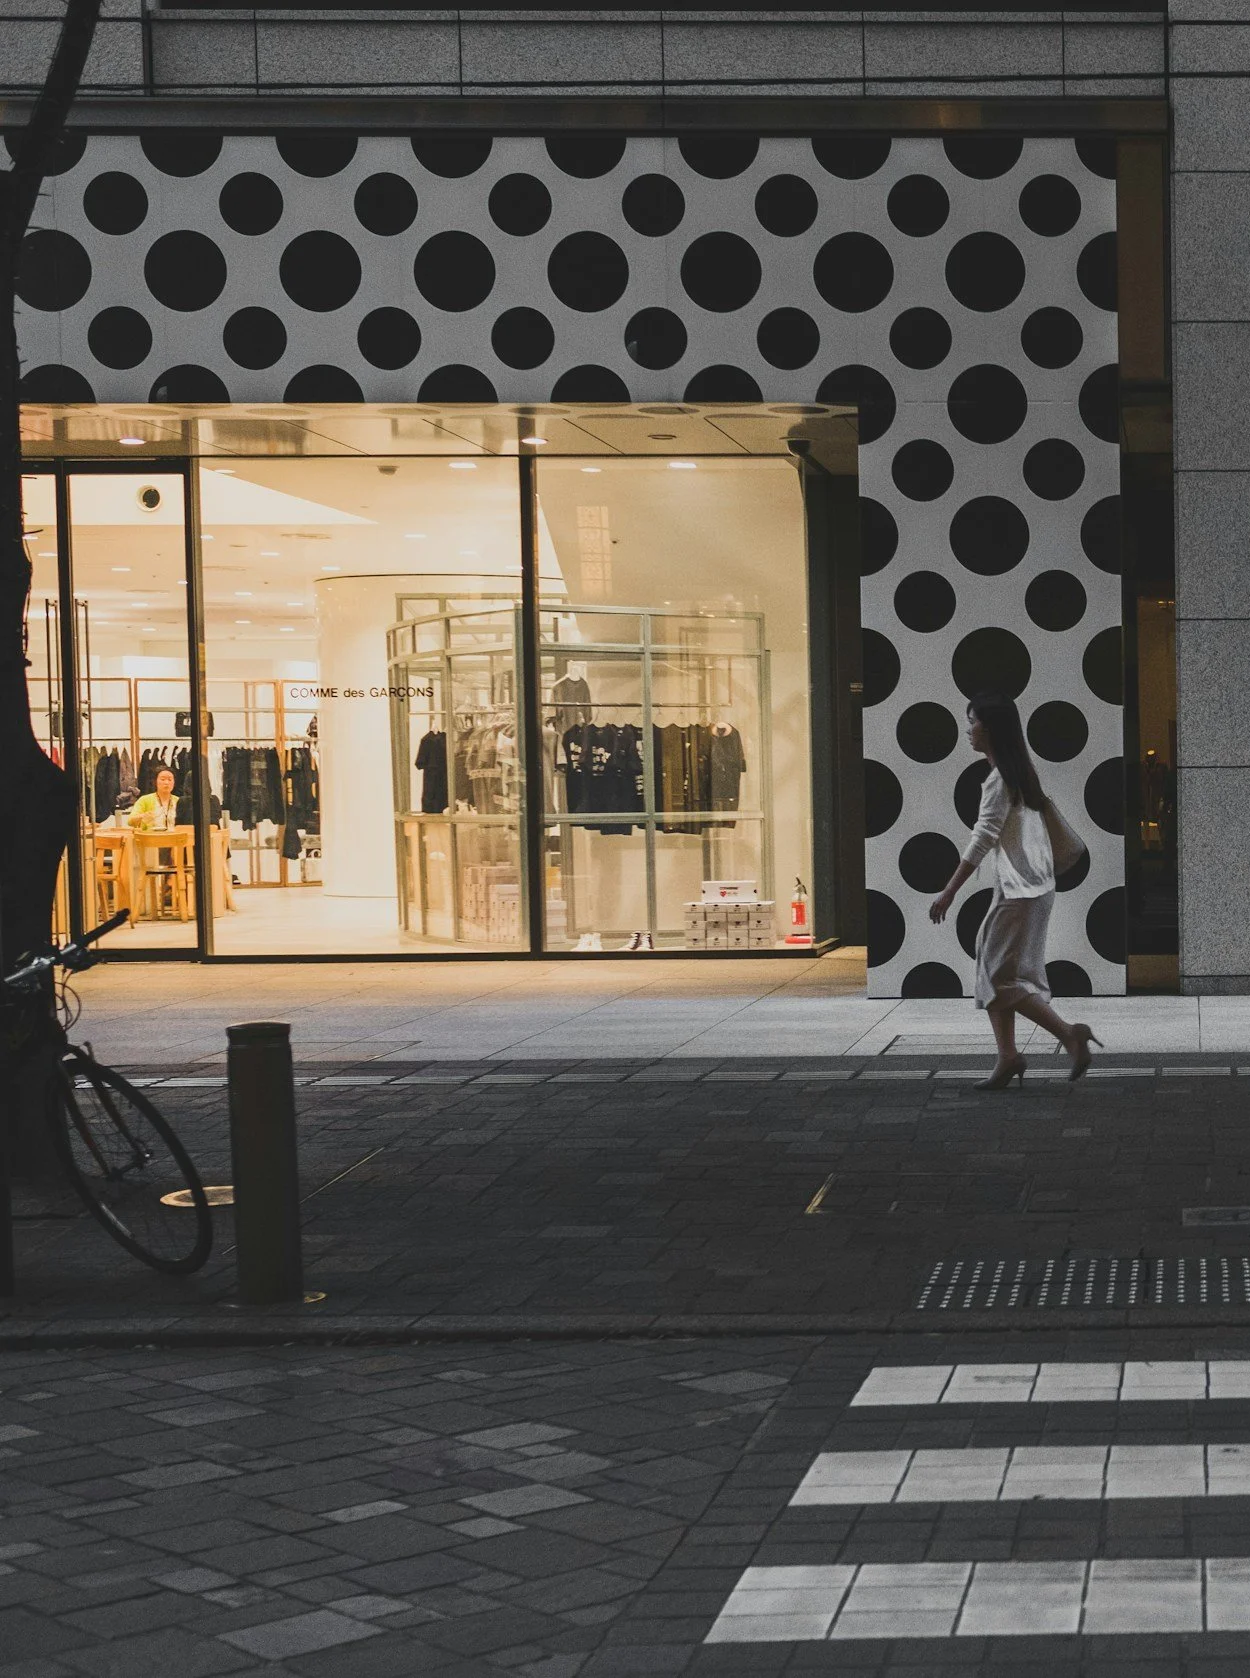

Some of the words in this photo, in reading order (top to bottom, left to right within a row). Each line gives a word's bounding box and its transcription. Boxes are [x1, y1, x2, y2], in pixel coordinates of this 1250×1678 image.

[290, 687, 338, 699] COMME
[343, 687, 365, 698] des
[370, 687, 434, 702] GARÇONS
